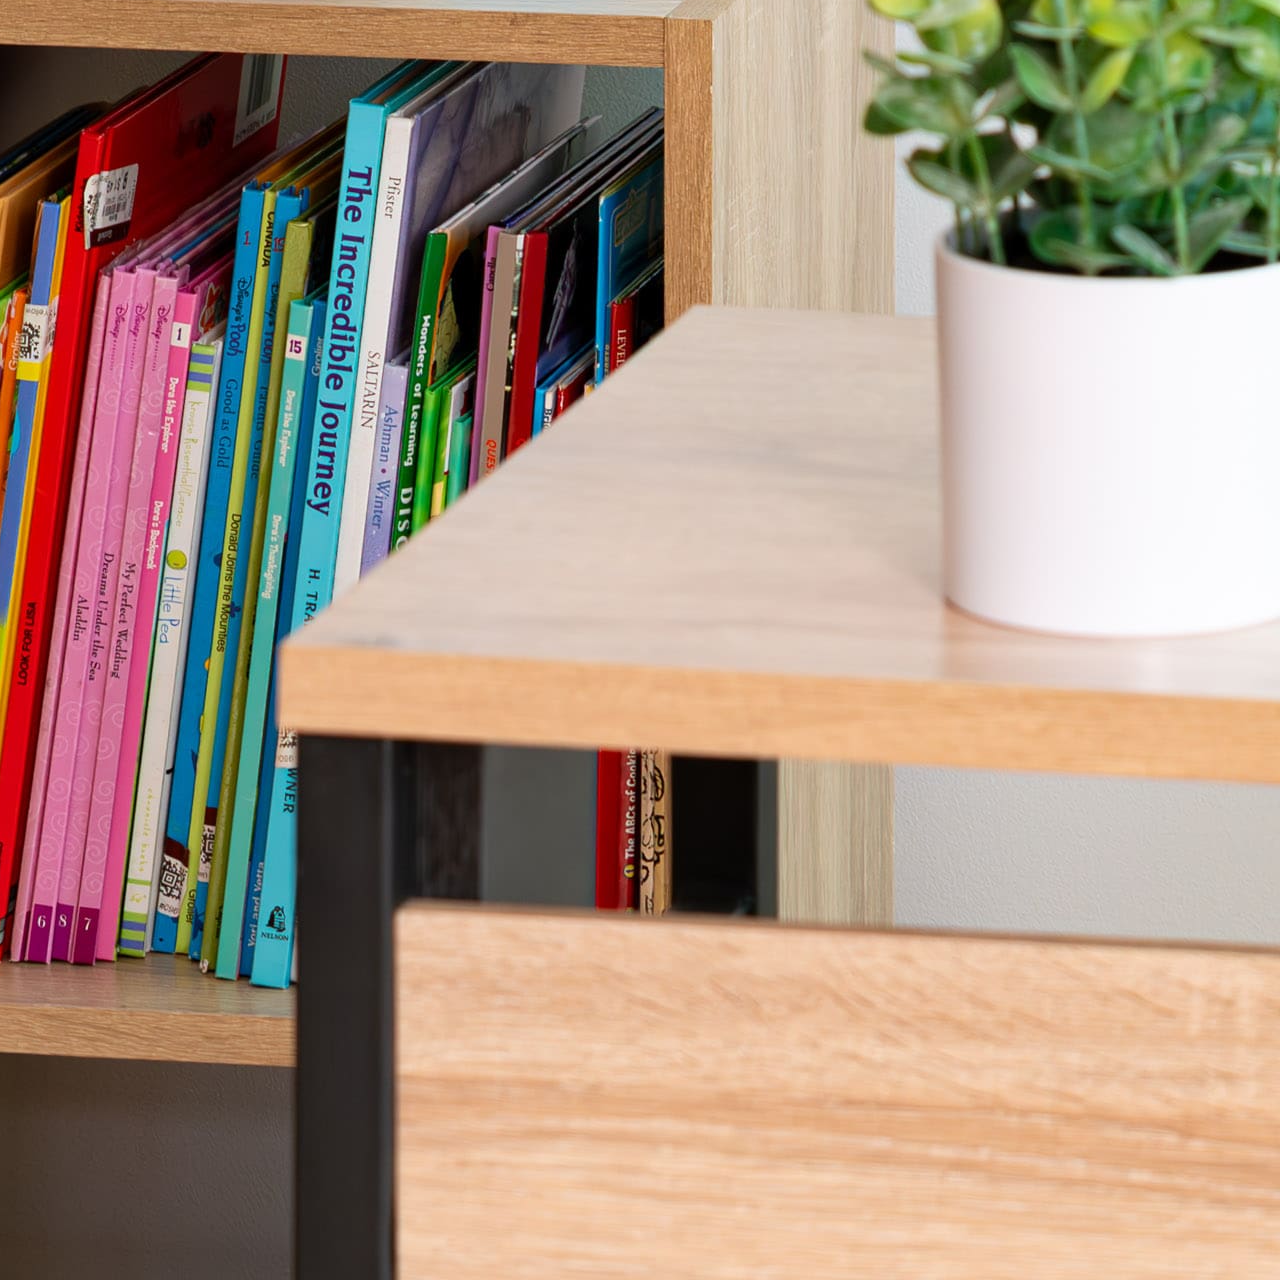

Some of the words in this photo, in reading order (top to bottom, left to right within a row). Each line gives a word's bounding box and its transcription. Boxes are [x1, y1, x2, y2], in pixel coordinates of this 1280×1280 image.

[343, 166, 373, 223] The
[387, 177, 401, 219] Pfister
[262, 211, 275, 267] CANADA
[110, 304, 128, 339] Disney
[130, 302, 148, 338] Disney
[152, 304, 171, 340] Disney
[325, 233, 365, 391] Incredible
[176, 328, 182, 341] 1
[227, 324, 246, 357] Pooh
[289, 339, 302, 354] 15
[416, 314, 431, 377] Wonders
[311, 337, 323, 376] Grolier
[168, 377, 179, 398] Dora
[225, 379, 238, 414] Good
[361, 351, 381, 429] SALTARÍN
[414, 382, 421, 399] of
[166, 400, 176, 414] the
[161, 416, 174, 453] Explorer
[221, 419, 229, 431] as
[380, 405, 398, 463] Ashman
[404, 404, 421, 467] Learning
[217, 435, 232, 468] Gold
[306, 400, 347, 516] Journey
[151, 501, 164, 528] Dora's
[372, 480, 391, 530] Winter
[227, 514, 242, 552] Donald
[98, 552, 114, 596] Dreams
[122, 562, 136, 581] My
[225, 551, 236, 582] Joins
[118, 584, 133, 624] Perfect
[163, 576, 184, 613] Little
[222, 584, 231, 601] the
[26, 602, 36, 629] LISA
[73, 594, 89, 641] Aladdin
[94, 599, 108, 634] Under
[159, 618, 180, 644] Pea
[217, 602, 231, 653] Mounties
[22, 631, 33, 652] FOR
[90, 637, 105, 658] the
[111, 628, 128, 679] Wedding
[18, 654, 29, 685] LOOK
[89, 660, 101, 681] Sea
[624, 789, 636, 802] of
[625, 805, 636, 834] ABCs
[624, 838, 635, 859] The
[38, 915, 46, 928] 6
[58, 914, 67, 927] 8
[252, 895, 261, 919] and
[83, 918, 92, 931] 7
[261, 932, 289, 941] NELSON
